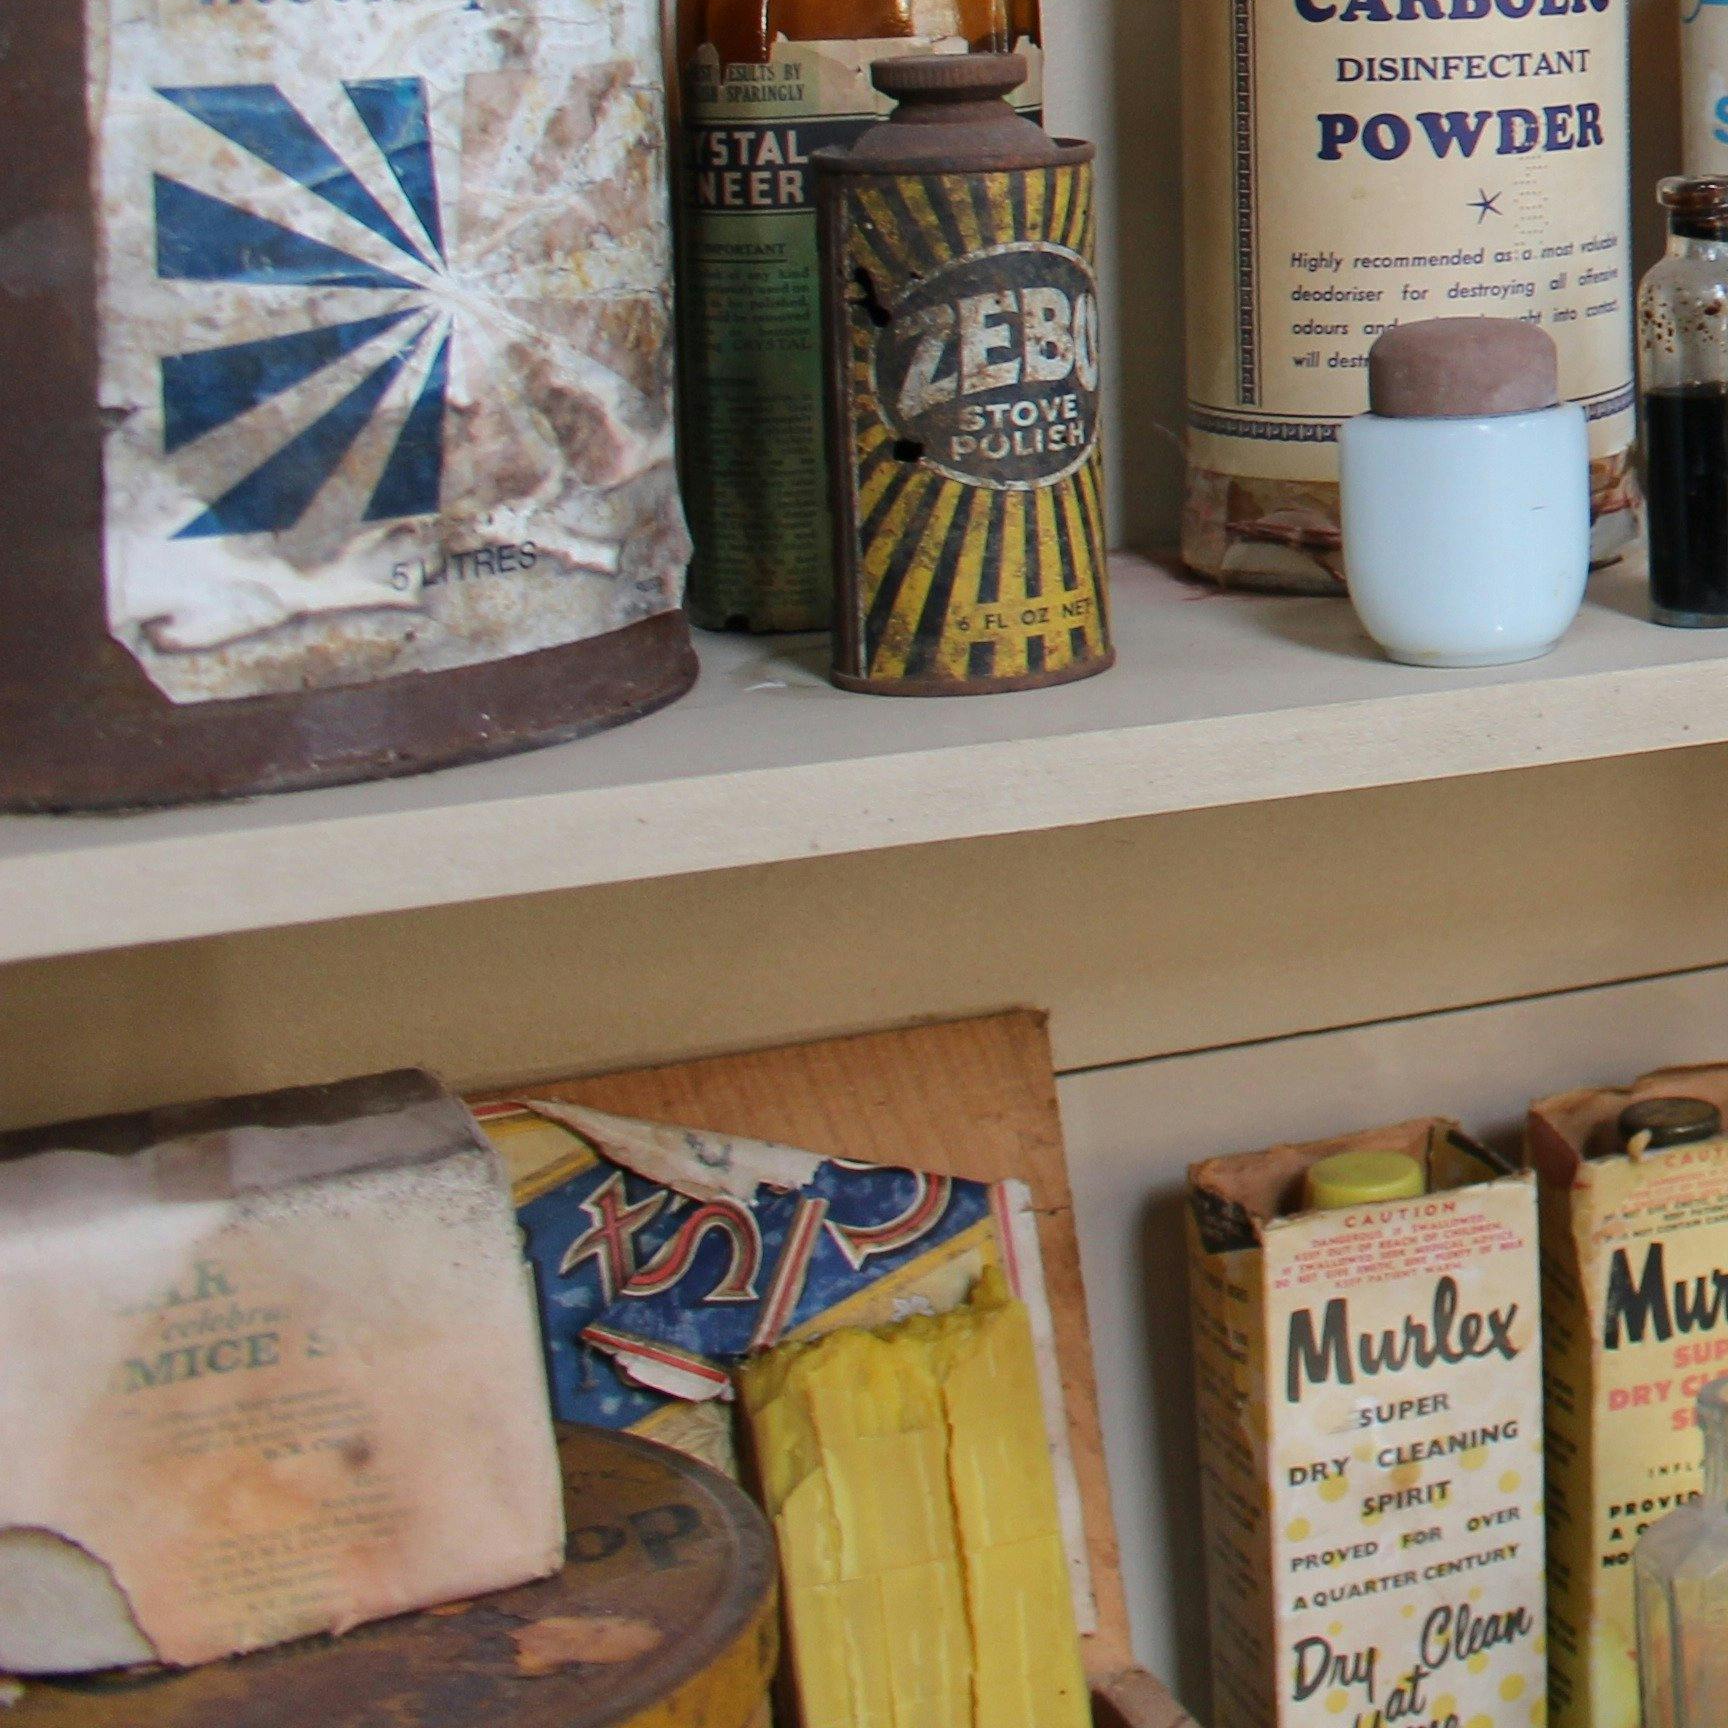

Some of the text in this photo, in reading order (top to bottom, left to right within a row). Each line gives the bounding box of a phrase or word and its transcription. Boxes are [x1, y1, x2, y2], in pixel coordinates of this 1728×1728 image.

[1335, 48, 1591, 84] DISINFECTANT
[1317, 102, 1604, 163] POWDER
[1291, 252, 1343, 272] Highly
[1353, 248, 1485, 269] recommended
[1494, 249, 1511, 263] as
[1291, 285, 1383, 303] deodoriser
[1402, 283, 1429, 301] for
[1447, 279, 1535, 300] destroying
[1550, 272, 1567, 291] all
[1293, 321, 1349, 335] odours
[1293, 353, 1320, 368] will
[960, 393, 1078, 432] STOVE
[951, 420, 1085, 462] POLISH
[389, 560, 409, 592] 5
[985, 611, 1006, 629] FL
[1022, 606, 1048, 625] OZ
[1063, 598, 1093, 618] NET
[1344, 1200, 1456, 1228] CAUTION
[1286, 1274, 1521, 1404] Murlex
[125, 1330, 281, 1393] MICE
[1358, 1390, 1452, 1430] SUPER
[1607, 1379, 1672, 1412] DRY
[1288, 1419, 1521, 1488] DRY CLEANING
[1361, 1479, 1454, 1520] SPIRIT
[1290, 1506, 1522, 1574] PROVED FOR OVER
[1293, 1542, 1521, 1611] A QUARTER CENTURY
[1292, 1601, 1535, 1705] Dry Clean
[1385, 1664, 1430, 1723] at
